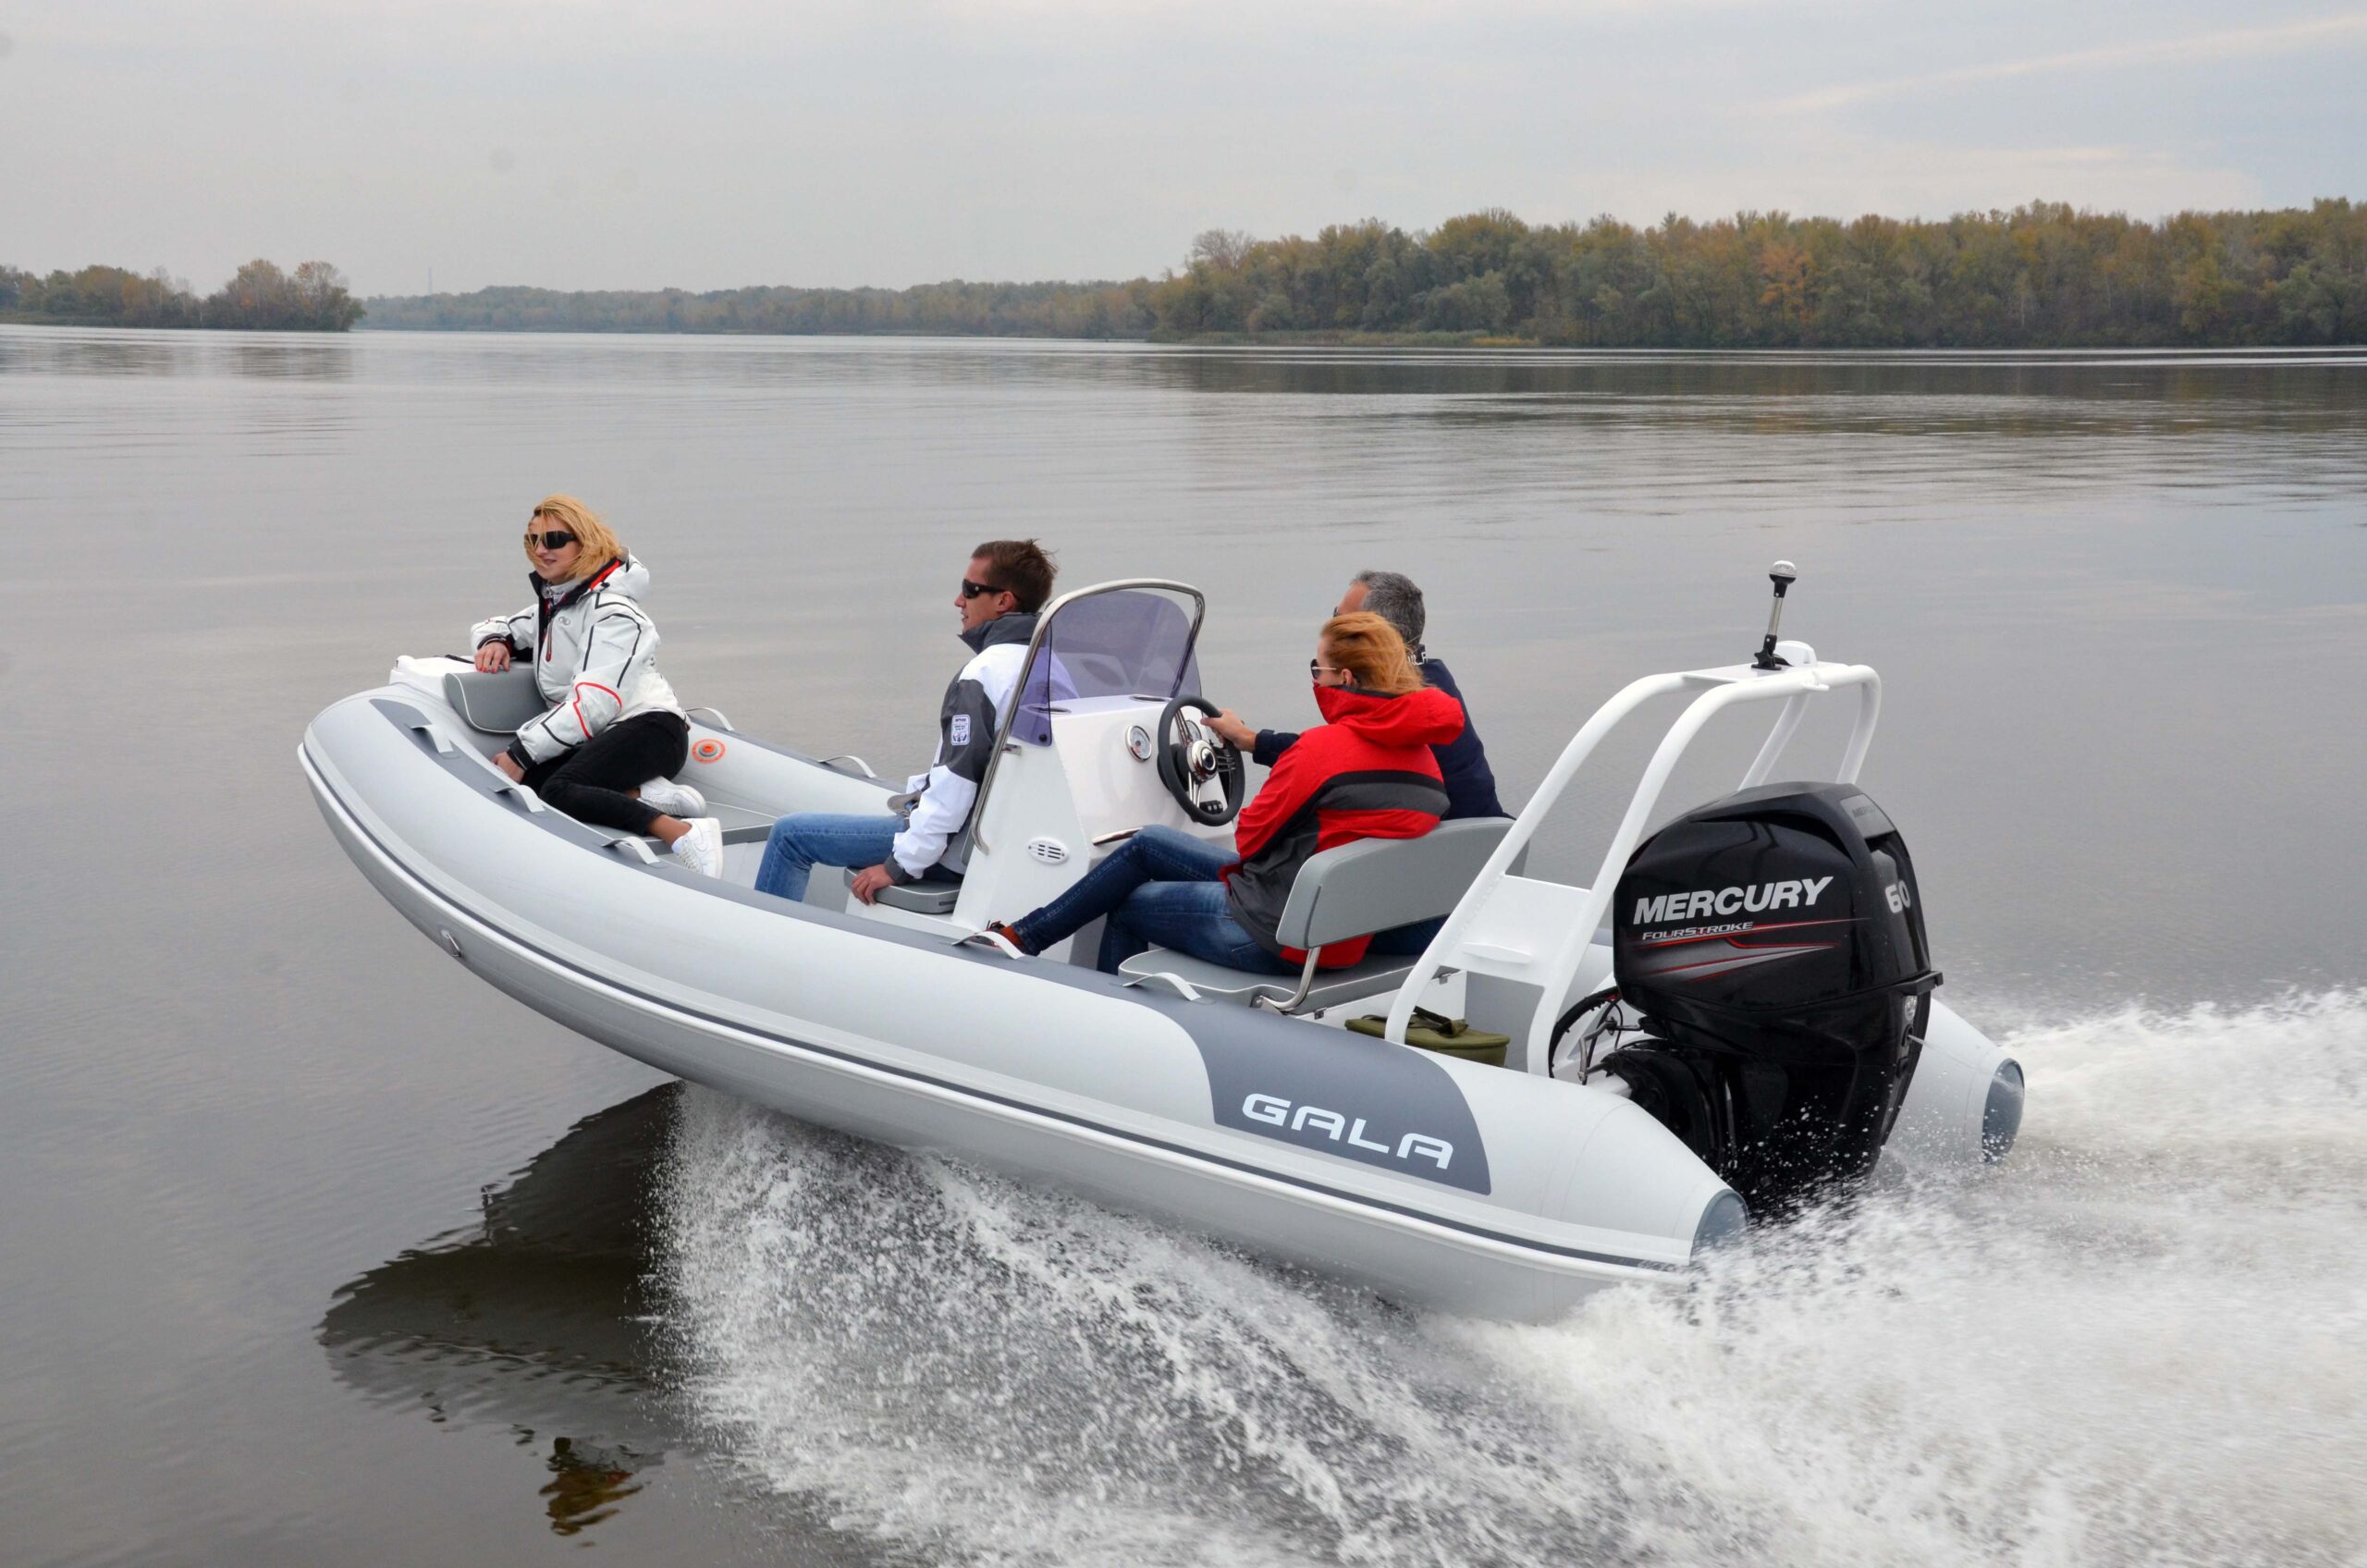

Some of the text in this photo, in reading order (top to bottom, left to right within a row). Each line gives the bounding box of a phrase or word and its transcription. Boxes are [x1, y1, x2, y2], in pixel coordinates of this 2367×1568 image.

[1633, 876, 1834, 925] MERCURY
[1884, 879, 1911, 913] 60
[1642, 921, 1754, 941] FOURSTROKE
[1242, 1093, 1453, 1170] GALA
